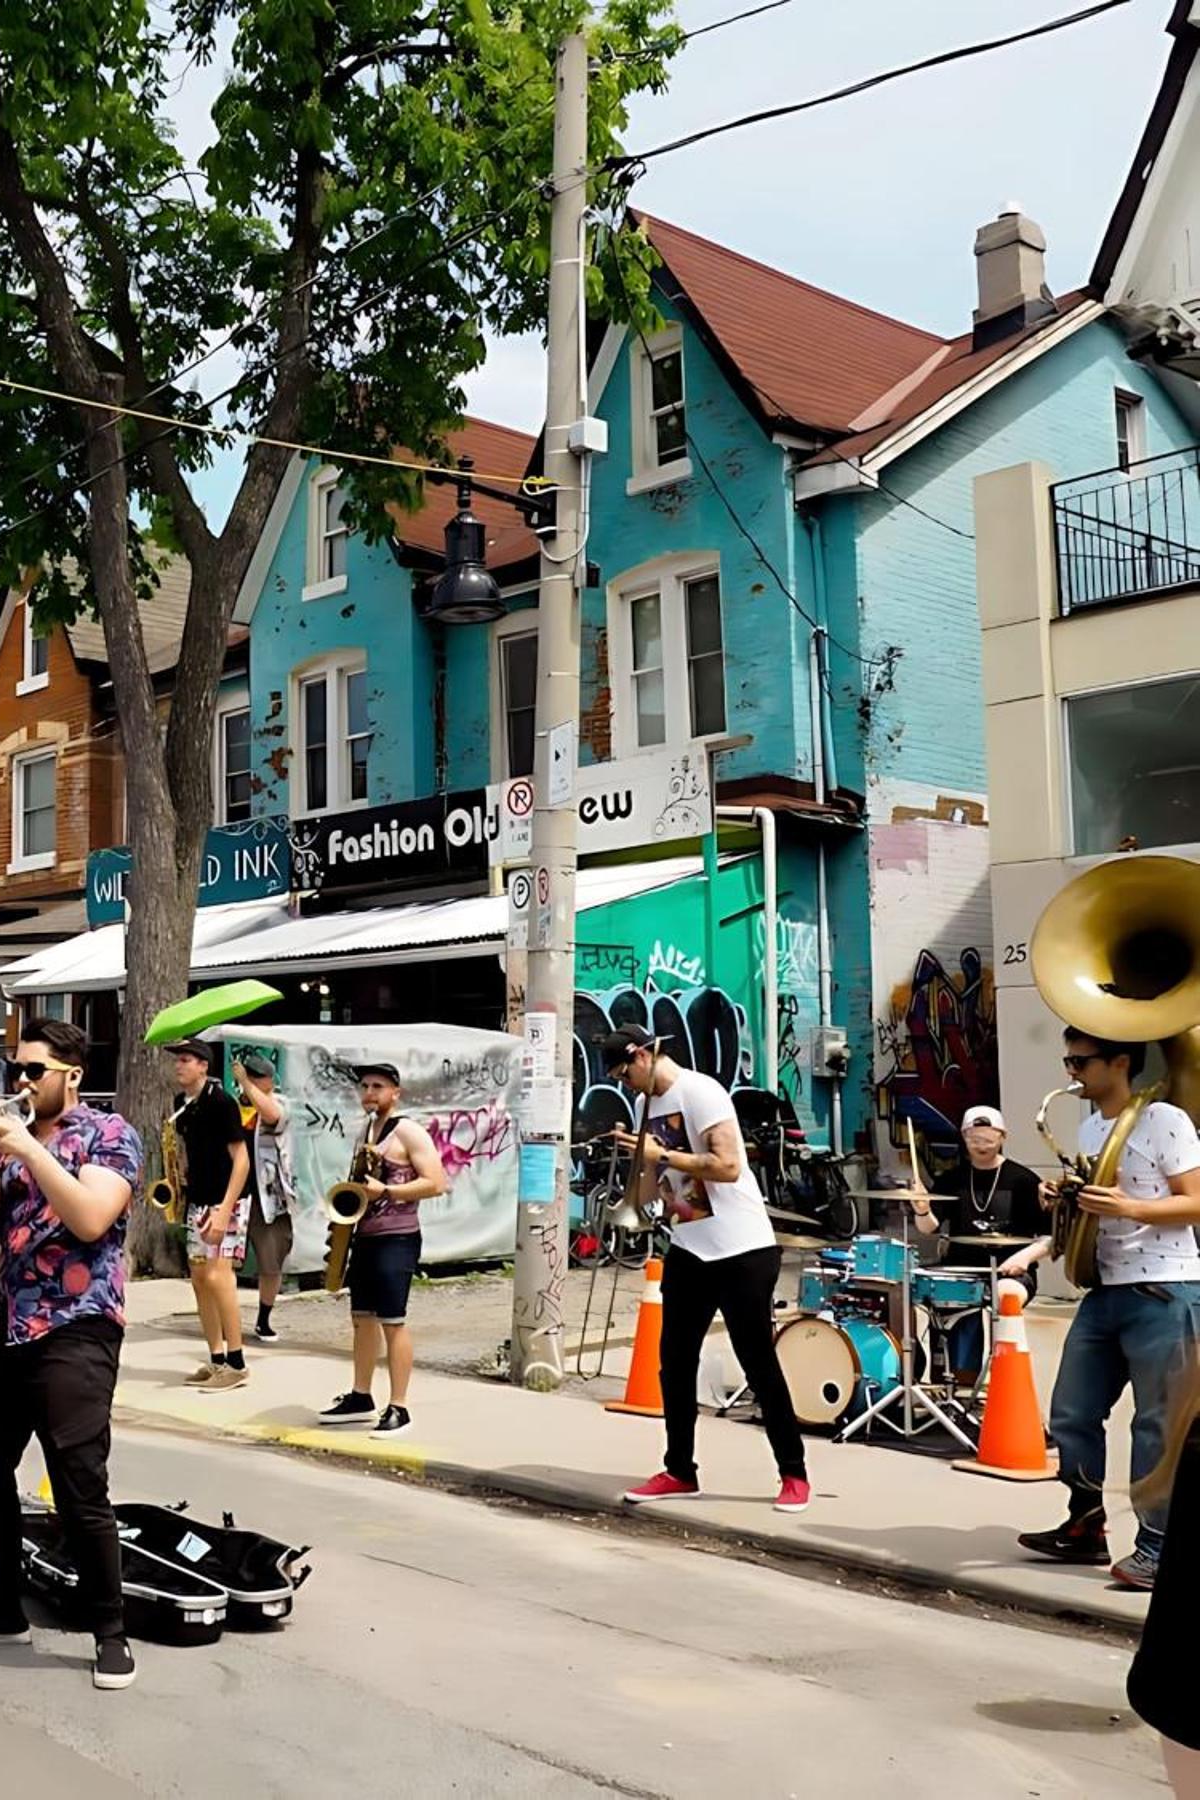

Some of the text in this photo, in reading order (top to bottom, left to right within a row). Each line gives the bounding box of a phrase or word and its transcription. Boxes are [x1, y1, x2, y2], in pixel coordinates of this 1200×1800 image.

[329, 818, 435, 865] Fashion
[444, 805, 500, 847] Old
[233, 842, 282, 881] INK
